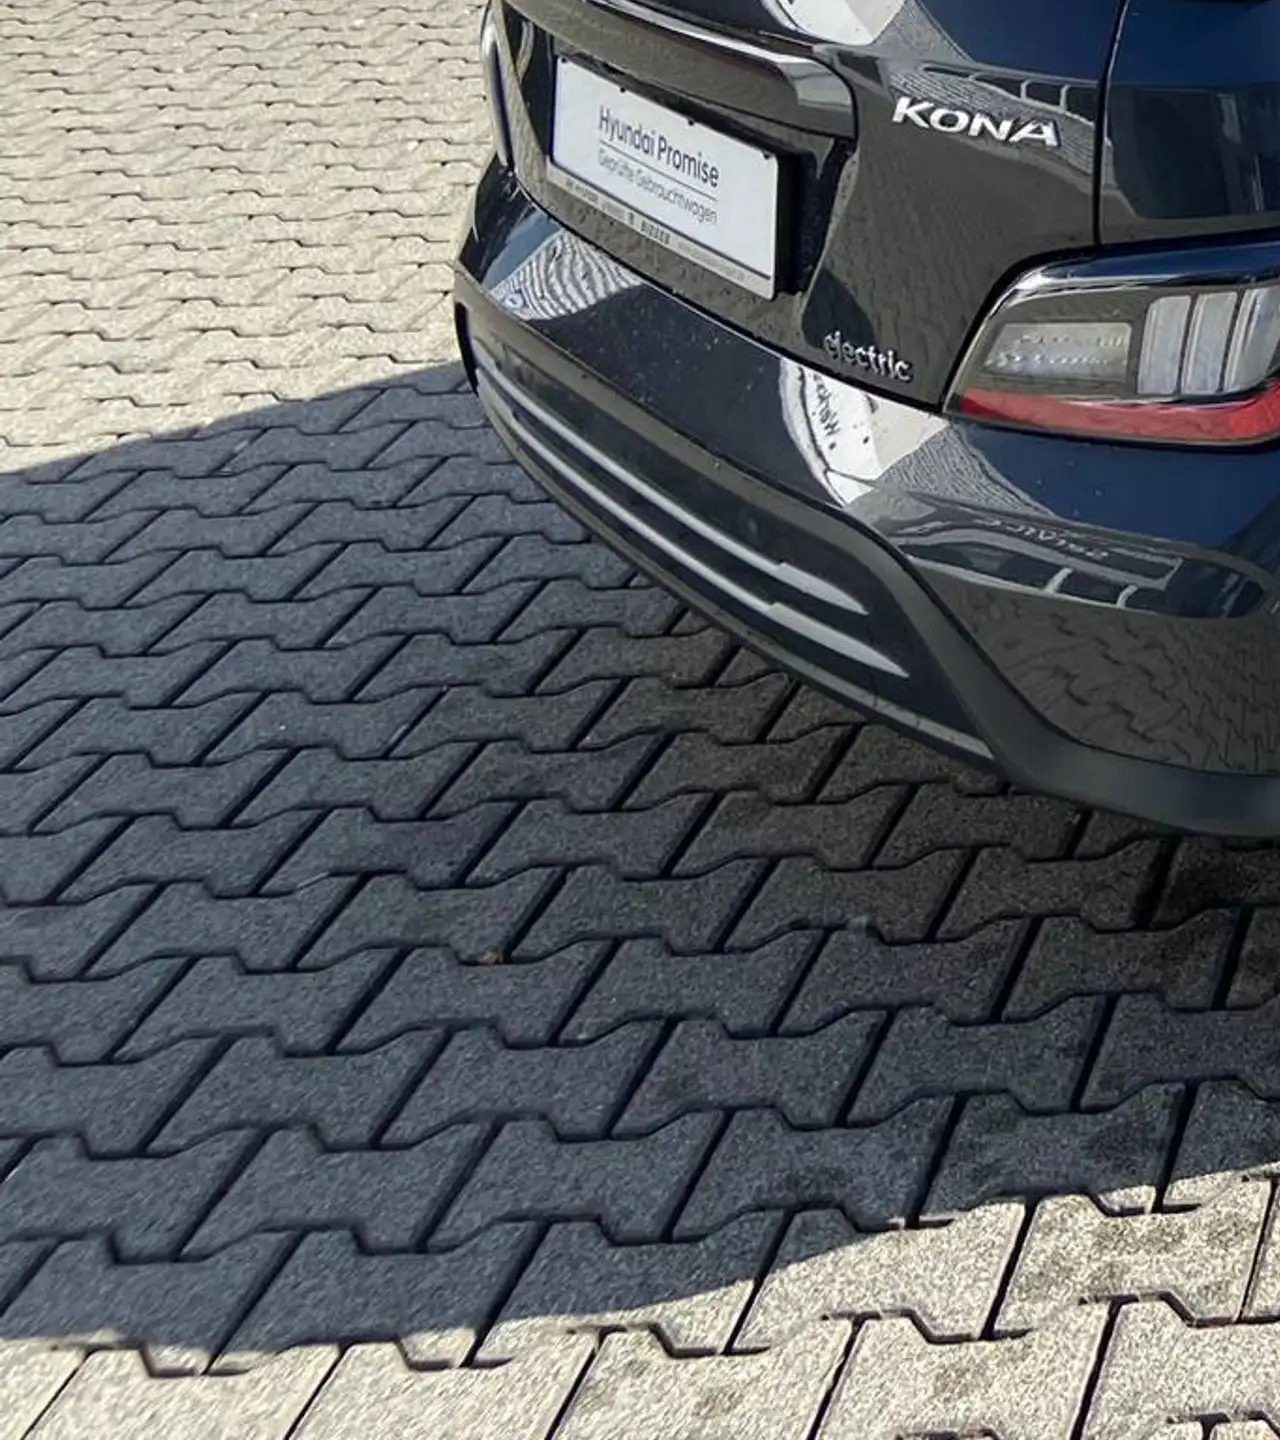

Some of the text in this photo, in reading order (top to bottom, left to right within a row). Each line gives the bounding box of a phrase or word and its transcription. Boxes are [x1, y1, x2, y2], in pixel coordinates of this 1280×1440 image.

[598, 105, 721, 189] Hyundai Promise
[892, 95, 1061, 149] KONA
[824, 330, 914, 384] electric
